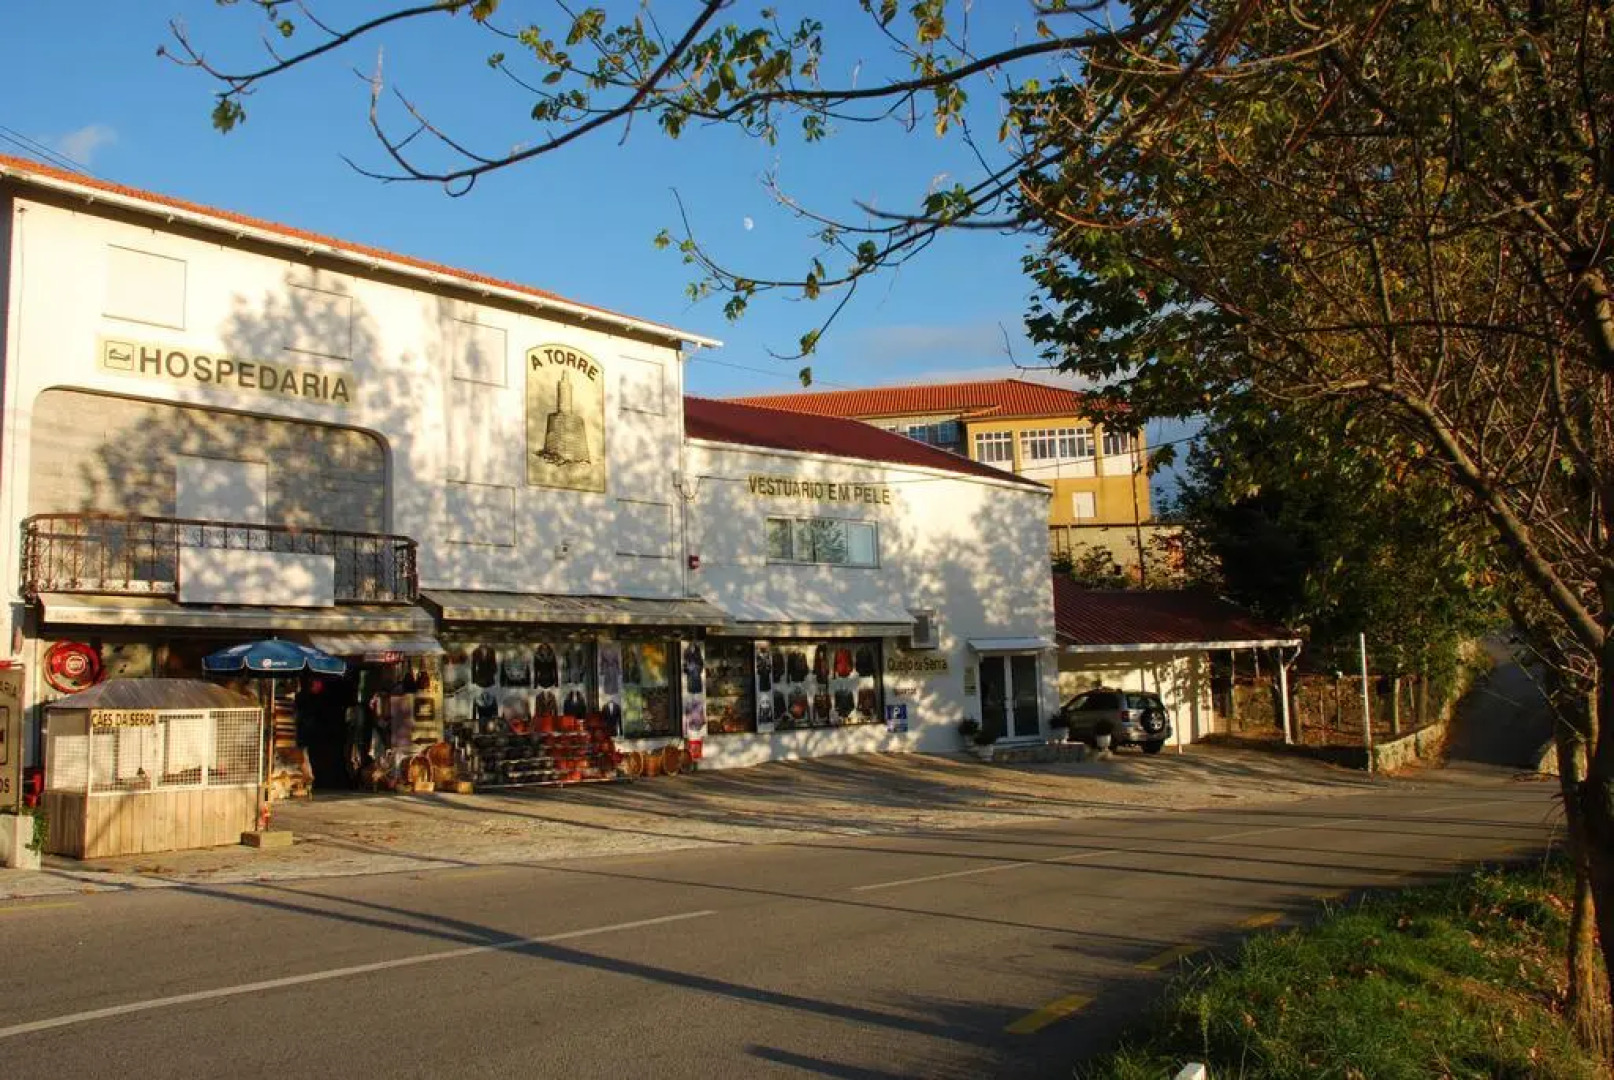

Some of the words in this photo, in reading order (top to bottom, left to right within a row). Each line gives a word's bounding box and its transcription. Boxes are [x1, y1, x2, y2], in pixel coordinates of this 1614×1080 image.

[139, 346, 350, 402] HOSPEDARIA
[531, 354, 543, 371] A
[543, 349, 599, 382] TORRE
[748, 475, 824, 499] VESTUARIO
[828, 483, 850, 501] EM
[854, 486, 890, 505] PELE
[923, 657, 948, 671] Serra
[116, 713, 129, 726] DA
[130, 713, 156, 727] SERRA
[893, 707, 901, 718] P
